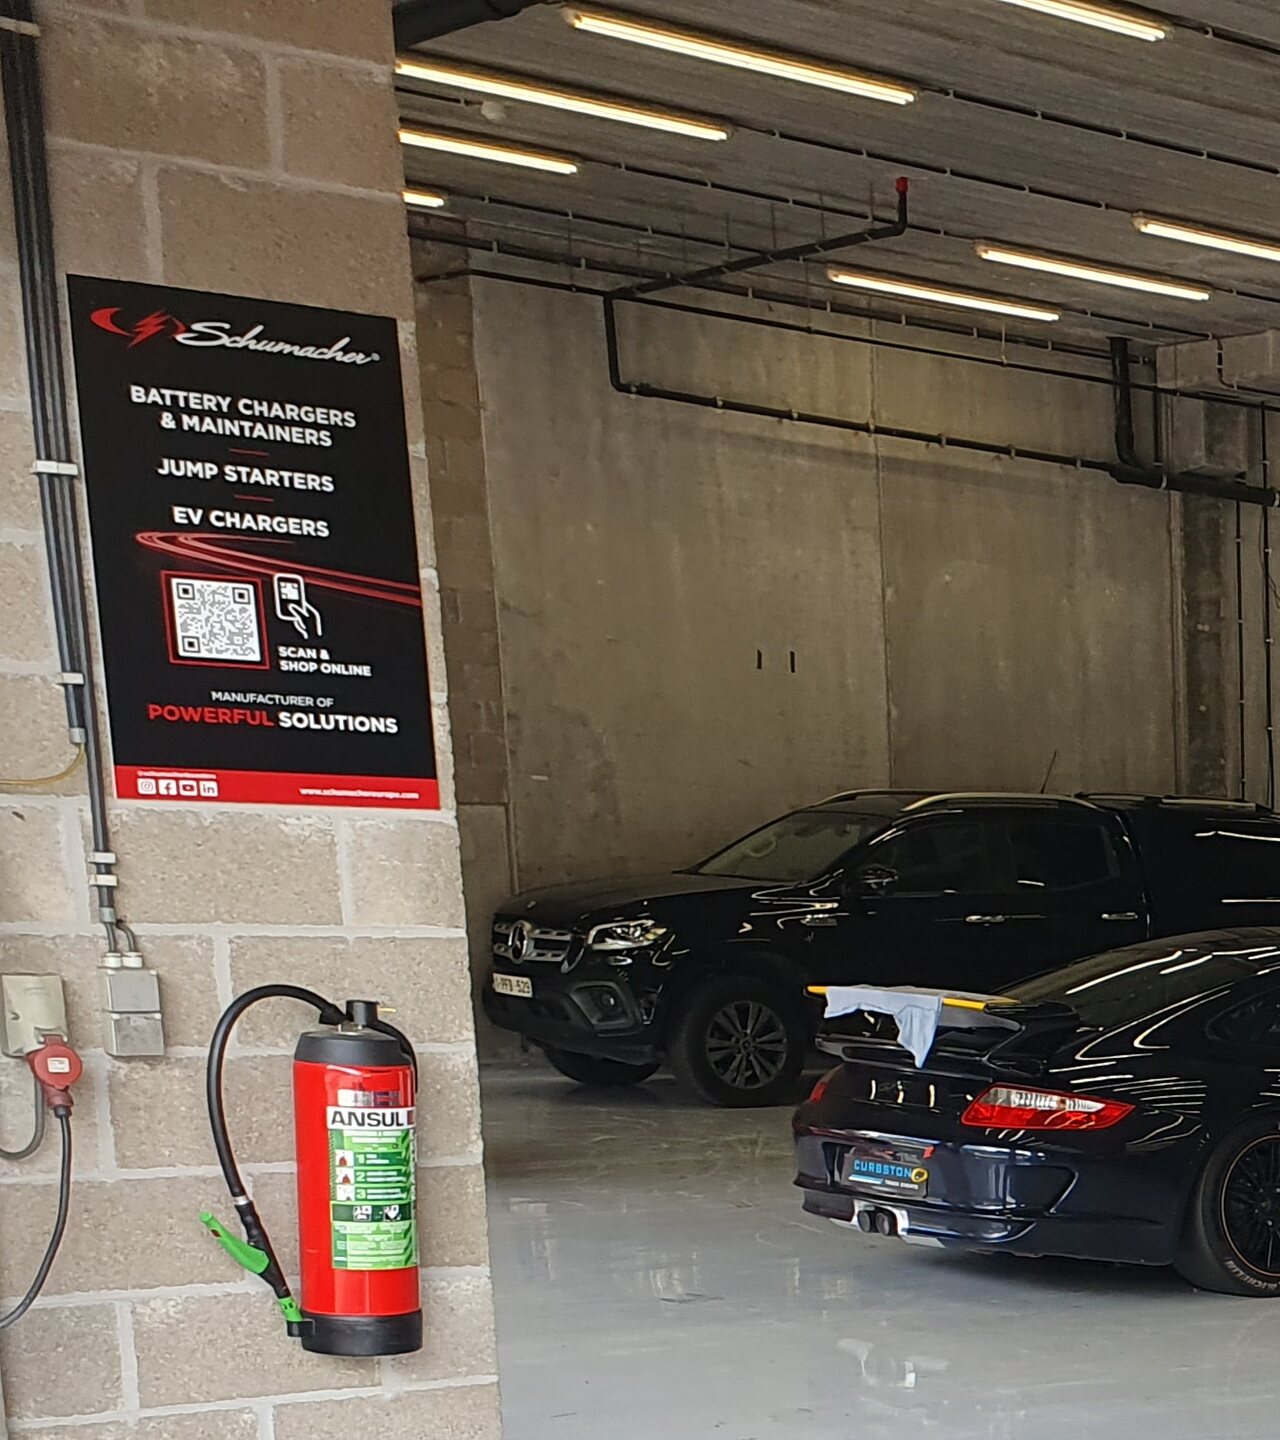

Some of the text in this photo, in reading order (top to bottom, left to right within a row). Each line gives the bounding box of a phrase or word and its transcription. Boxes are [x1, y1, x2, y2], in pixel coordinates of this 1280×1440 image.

[176, 321, 375, 365] Schumacher
[130, 385, 357, 428] BATTERY CHARGERS
[160, 411, 333, 447] & MAINTAINERS
[157, 457, 335, 492] JUMP STARTERS
[172, 506, 330, 537] EV CHARGERS
[278, 646, 330, 660] SCAN &
[280, 660, 372, 677] SHOP ONLINE
[211, 691, 334, 708] MANUFACTURER OF
[147, 704, 399, 734] POWERFUL SOLUTIONS
[331, 1111, 404, 1128] ANSUL
[356, 1154, 366, 1164] 1
[356, 1172, 366, 1182] 2
[854, 1160, 918, 1180] CURBSTON
[356, 1189, 366, 1199] 3
